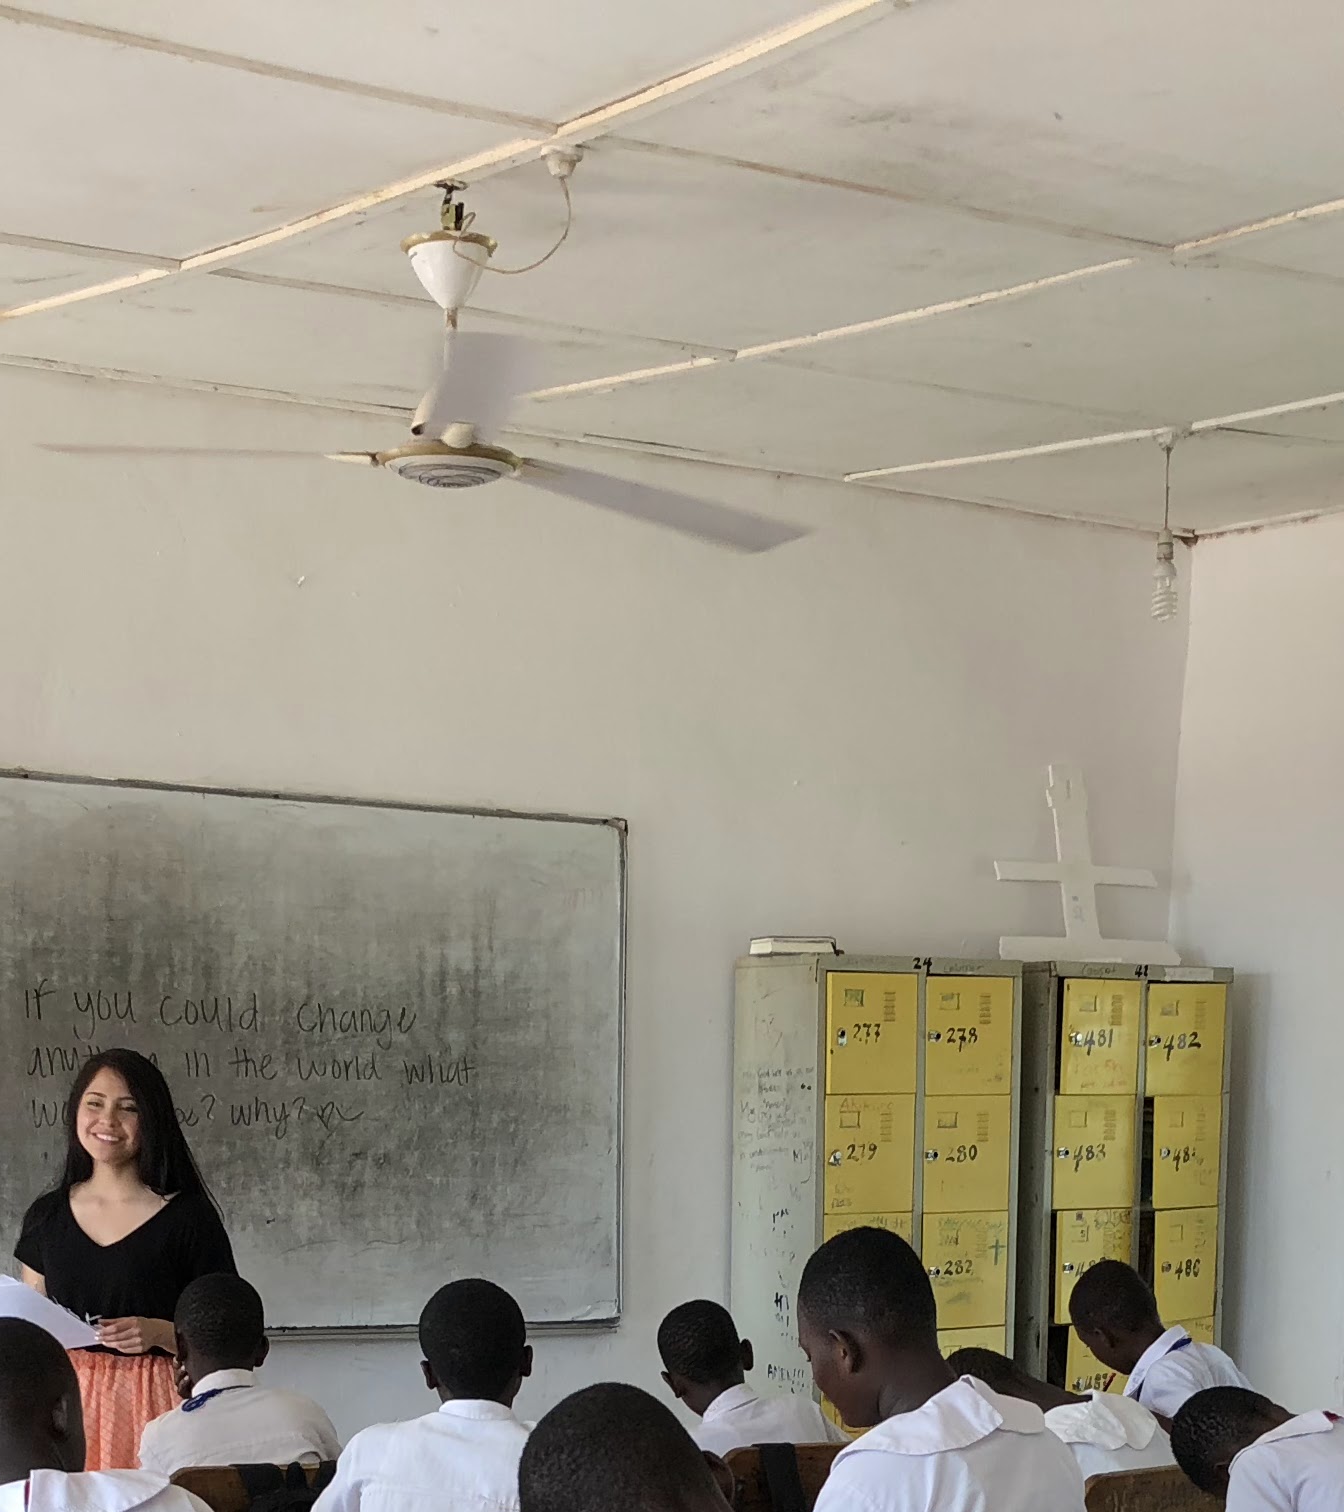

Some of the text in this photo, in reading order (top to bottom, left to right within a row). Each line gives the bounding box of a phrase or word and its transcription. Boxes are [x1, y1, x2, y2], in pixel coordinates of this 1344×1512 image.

[912, 957, 932, 975] 24
[25, 978, 417, 1050] If you could change
[946, 1027, 978, 1052] 278
[1084, 1029, 1114, 1056] 481
[1163, 1031, 1202, 1061] 482
[185, 1051, 211, 1078] in
[228, 1047, 278, 1080] the
[297, 1052, 383, 1081] world
[403, 1055, 476, 1085] what
[230, 1096, 306, 1139] why?
[846, 1143, 878, 1162] 279
[945, 1144, 978, 1162] 280
[1073, 1144, 1106, 1173] 483
[943, 1259, 974, 1276] 282
[1175, 1258, 1201, 1280] 486
